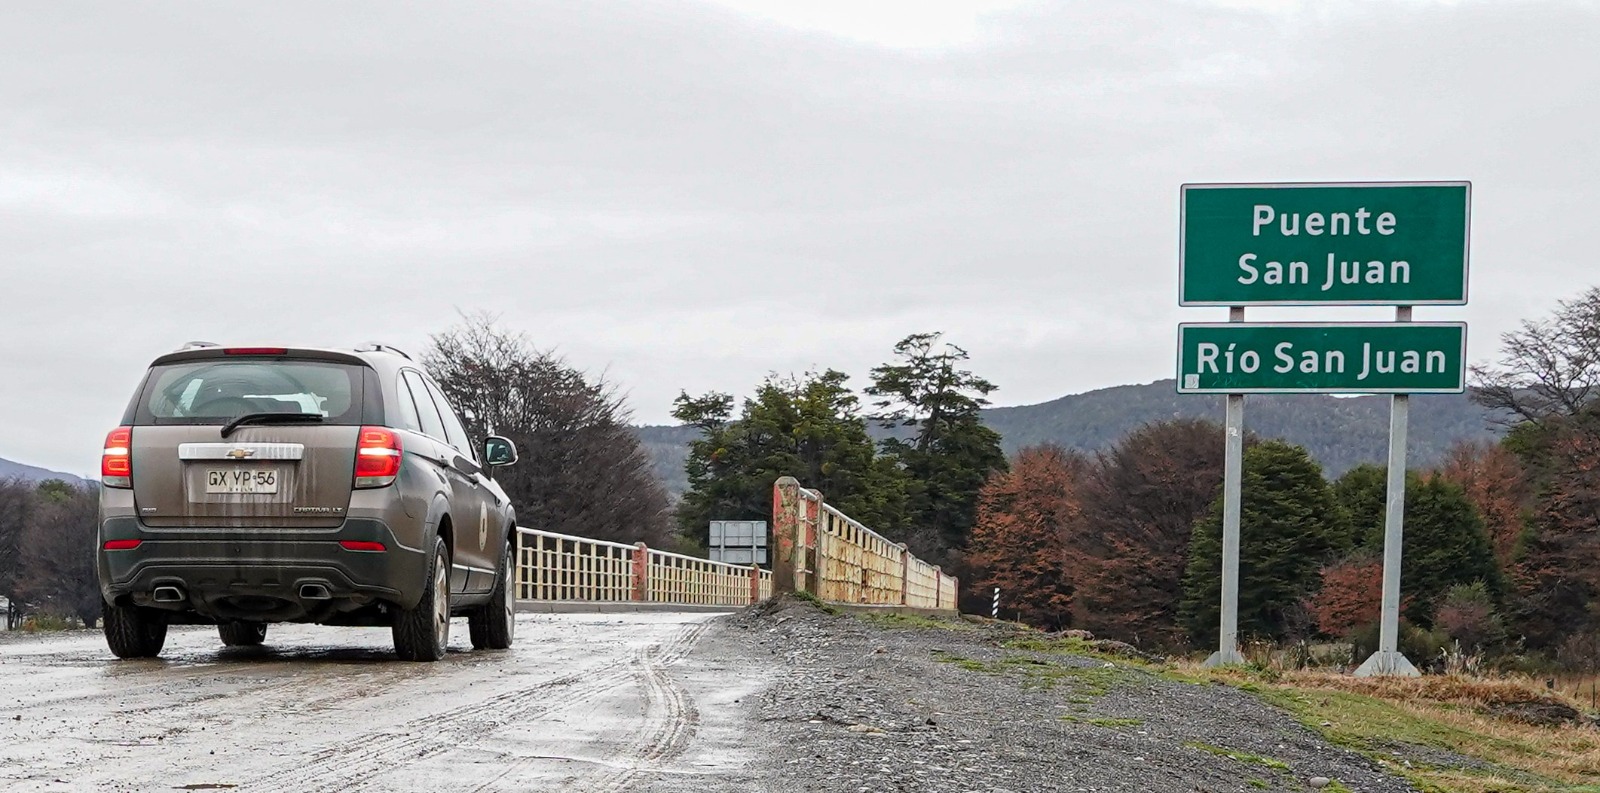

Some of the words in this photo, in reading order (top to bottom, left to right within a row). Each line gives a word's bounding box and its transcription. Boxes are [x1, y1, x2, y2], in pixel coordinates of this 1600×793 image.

[1252, 204, 1397, 236] Puente
[1237, 253, 1310, 285] San
[1321, 252, 1411, 291] Juan
[1197, 342, 1261, 373] Río
[1273, 342, 1345, 374] San
[1357, 342, 1447, 380] Juan
[208, 471, 228, 486] GX
